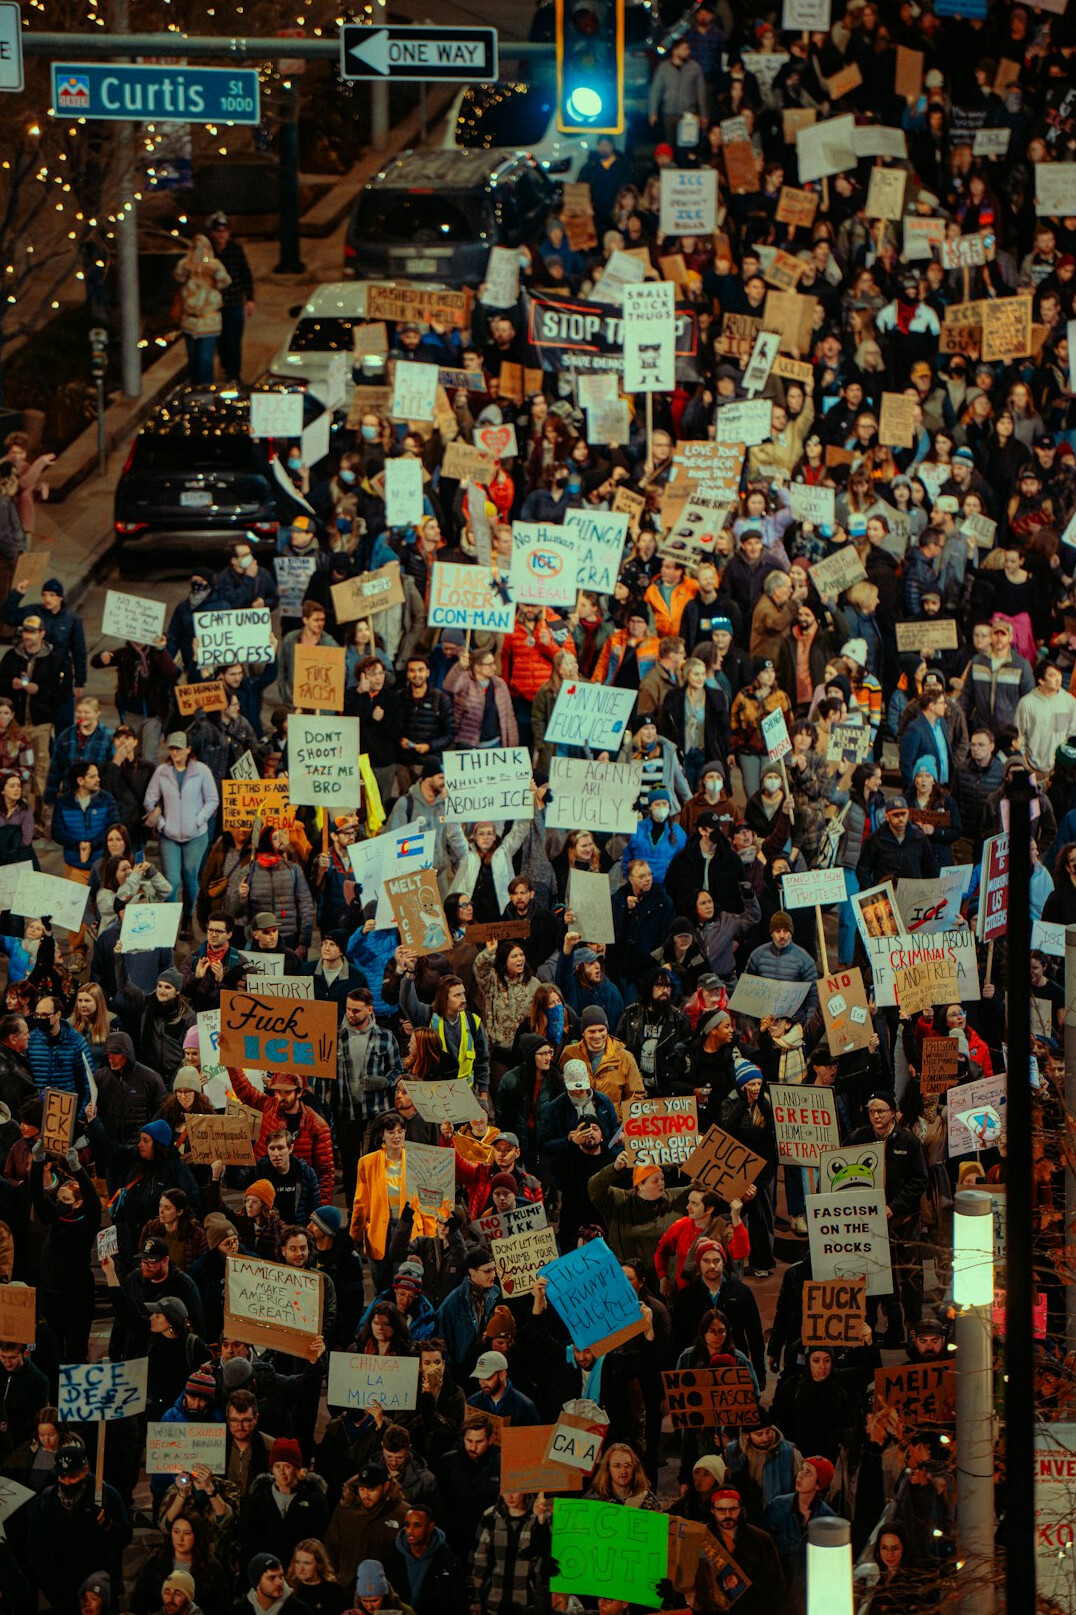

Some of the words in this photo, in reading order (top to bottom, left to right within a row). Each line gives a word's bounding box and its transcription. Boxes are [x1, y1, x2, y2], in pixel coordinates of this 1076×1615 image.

[389, 43, 429, 62] ONE
[437, 44, 478, 64] WAY
[101, 76, 205, 112] Curtis
[229, 80, 244, 95] St
[220, 97, 253, 112] 1000
[632, 301, 669, 311] DICK
[543, 311, 601, 341] STOP
[513, 531, 531, 550] No
[537, 528, 575, 551] Human
[531, 553, 557, 570] ICE
[437, 566, 487, 590] LIAR
[435, 589, 495, 609] LOSER
[235, 612, 270, 627] UNDO
[433, 607, 510, 628] CON-MAN
[201, 631, 236, 648] DUE
[201, 645, 273, 666] PROCESS
[305, 665, 332, 685] FUCK
[179, 687, 193, 697] NO
[182, 699, 192, 709] IS
[595, 690, 625, 716] NICE
[305, 730, 342, 744] DON'T
[551, 712, 588, 740] FUCK
[588, 720, 613, 744] ICE
[297, 746, 343, 763] SHOOT!
[456, 750, 524, 772] THINK
[305, 765, 333, 776] TAZE
[337, 766, 354, 776] ME
[552, 760, 573, 779] ICE
[584, 761, 640, 786] AGENTS
[228, 783, 242, 795] IF
[244, 783, 261, 793] THIS
[264, 784, 272, 792] IS
[312, 780, 342, 793] BRO
[446, 776, 483, 790] WHILE
[581, 783, 602, 796] ARE
[242, 796, 266, 807] LAW
[446, 796, 495, 817] ABOLISH
[500, 788, 534, 808] ICE
[557, 796, 624, 826] FUGLY
[265, 814, 297, 829] FELON
[389, 875, 422, 896] MELT
[791, 886, 844, 904] PROTEST
[992, 890, 1004, 912] US
[911, 907, 945, 921] ICE
[399, 905, 414, 945] ICE
[911, 933, 936, 952] NOT
[942, 930, 975, 949] ABOUT
[890, 947, 957, 970] CRIMINALS
[826, 973, 852, 993] NO
[874, 967, 886, 985] IF
[896, 969, 921, 995] LAND
[926, 960, 956, 980] FREE
[247, 982, 313, 999] HISTORY
[226, 994, 309, 1040] Fuck
[243, 1035, 315, 1066] ICE
[938, 1064, 946, 1072] A
[406, 1082, 467, 1100] FUCK
[776, 1090, 801, 1107] LAND
[811, 1093, 829, 1109] THE
[47, 1093, 73, 1116] FU
[415, 1102, 458, 1120] ICE
[629, 1100, 659, 1119] get
[664, 1098, 692, 1113] your
[44, 1113, 69, 1137] CK
[624, 1114, 696, 1137] GESTAPO
[774, 1106, 832, 1127] GREED
[667, 1135, 692, 1149] our
[780, 1124, 806, 1141] HOME
[815, 1126, 833, 1142] THE
[44, 1135, 69, 1154] ICE
[701, 1127, 759, 1180] FUCK
[696, 1159, 734, 1196] ICE
[479, 1216, 501, 1231] NO
[503, 1204, 543, 1223] TRUMP
[813, 1205, 879, 1219] FASCISM
[820, 1224, 840, 1235] ON
[844, 1223, 870, 1234] THE
[518, 1237, 532, 1251] LET
[532, 1232, 553, 1246] THEM
[824, 1242, 872, 1255] ROCKS
[505, 1250, 531, 1266] NUMB
[534, 1245, 558, 1259] YOUR
[230, 1259, 318, 1291] IMMIGRANTS
[544, 1251, 602, 1294] FUCK
[239, 1288, 294, 1310] AMERICA
[255, 1282, 288, 1298] MAKE
[807, 1285, 863, 1311] FUCK
[247, 1303, 297, 1325] GREAT!
[565, 1292, 617, 1336] FUCK
[350, 1356, 400, 1373] CHINGA
[59, 1363, 130, 1388] ICE
[367, 1374, 384, 1387] LA
[664, 1371, 697, 1390] NO
[707, 1368, 752, 1386] ICE
[668, 1391, 704, 1410] NO
[59, 1405, 125, 1422] NUTS
[671, 1411, 705, 1428] NO
[713, 1408, 760, 1426] KINGS
[552, 1434, 596, 1462] CAVA
[553, 1502, 650, 1543] ICE
[559, 1544, 661, 1591] OUT!
